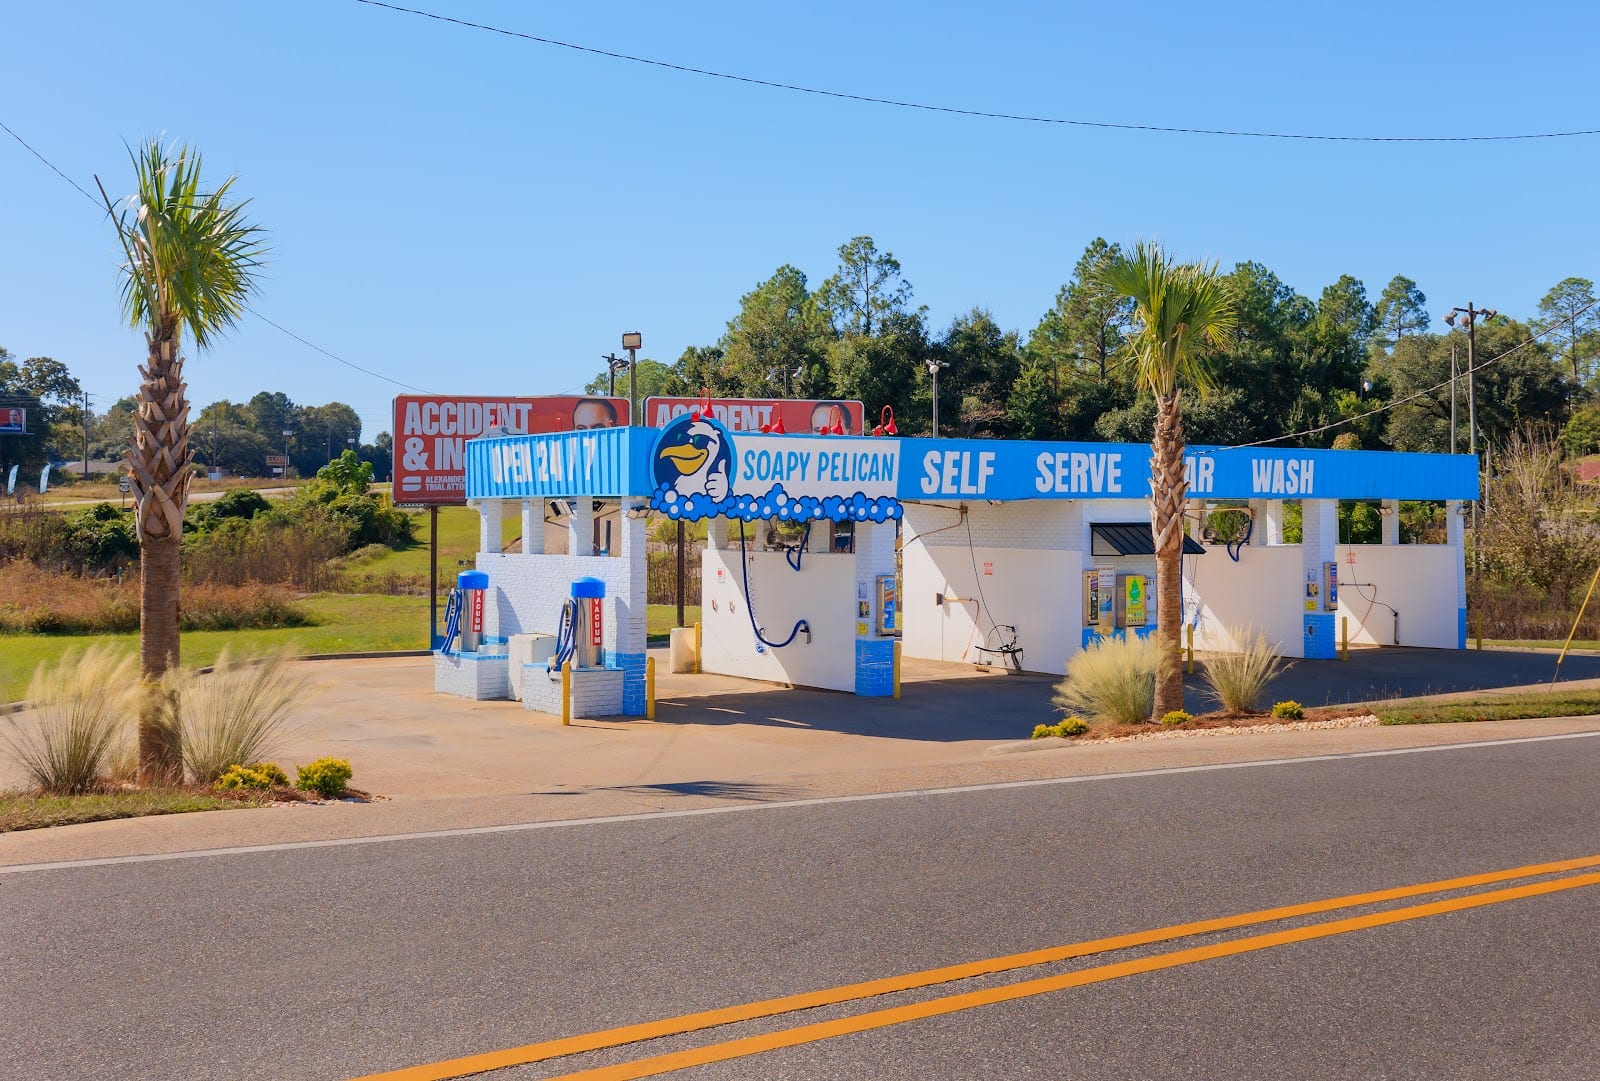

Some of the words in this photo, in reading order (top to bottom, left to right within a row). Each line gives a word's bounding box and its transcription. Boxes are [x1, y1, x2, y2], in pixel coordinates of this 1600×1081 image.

[403, 401, 533, 435] ACCIDENT
[402, 437, 429, 471] &
[491, 442, 533, 484] OPEN
[743, 449, 811, 482] SOAPY
[817, 451, 895, 482] PELICAN
[920, 450, 996, 495] SELF
[1035, 452, 1122, 494] SERVE
[1184, 456, 1215, 493] AR
[1252, 459, 1315, 495] WASH
[474, 590, 482, 631] VACUUM
[593, 599, 601, 644] VACUUM
